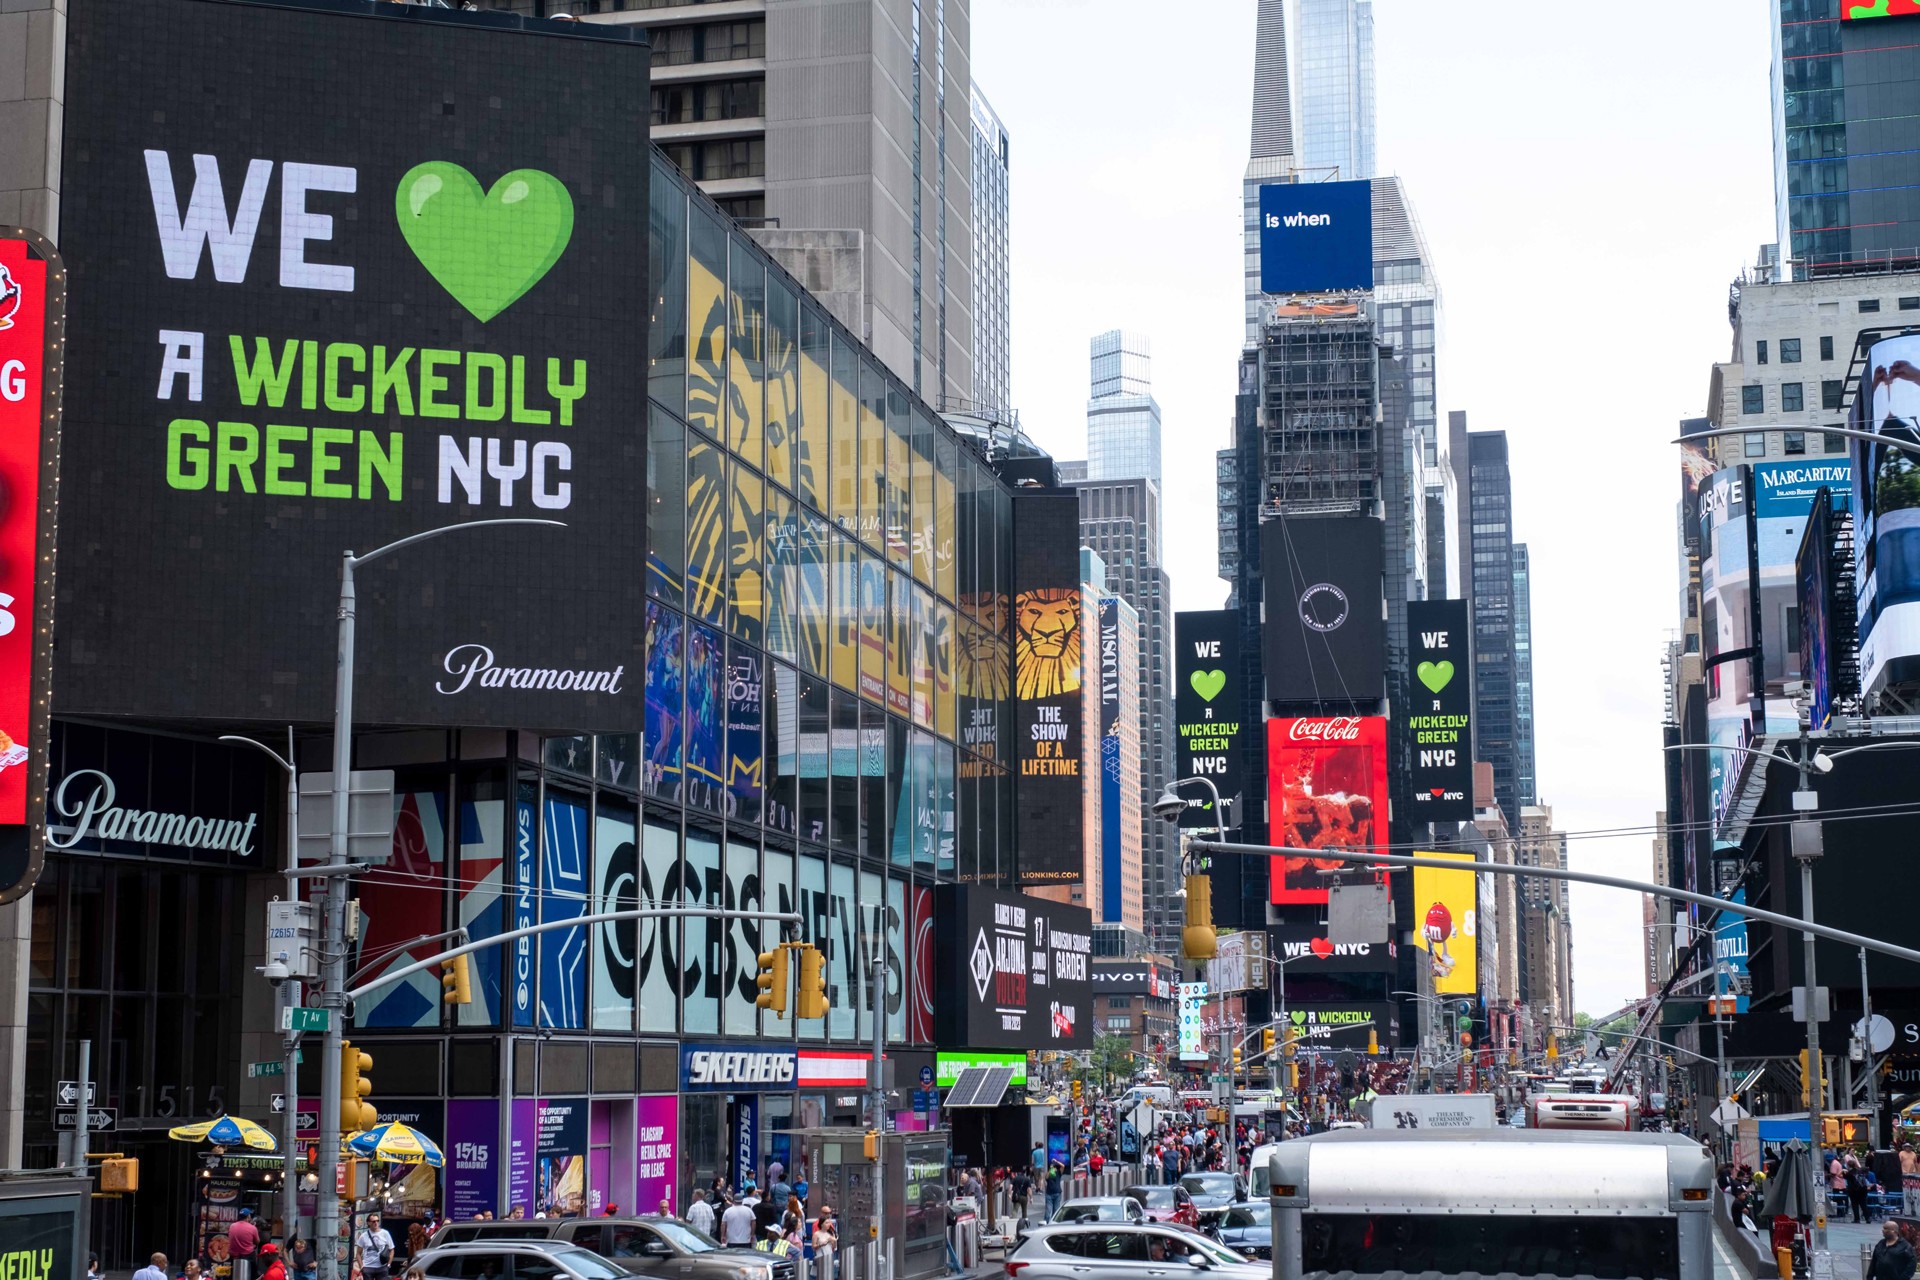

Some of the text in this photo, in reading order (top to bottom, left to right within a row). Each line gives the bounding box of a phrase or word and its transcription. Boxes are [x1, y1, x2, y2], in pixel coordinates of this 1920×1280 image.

[144, 149, 357, 292] WE
[1266, 212, 1330, 227] is when
[157, 329, 587, 426] A WICKEDLY
[166, 418, 572, 509] GREEN NYC
[1700, 480, 1743, 518] USIVE
[1421, 631, 1449, 649] WE
[1194, 641, 1221, 659] WE
[436, 644, 624, 694] Paramount
[862, 679, 884, 697] ENTRANCE
[1205, 708, 1212, 719] A
[1433, 700, 1441, 711] A
[1037, 706, 1061, 723] THE
[1410, 715, 1468, 730] WICKEDLY
[1031, 724, 1068, 741] SHOW
[1180, 722, 1239, 738] WICKEDLY
[1417, 730, 1458, 744] GREEN
[1036, 741, 1063, 758] OF A
[1190, 738, 1229, 751] GREEN
[1192, 756, 1227, 774] NYC
[1420, 750, 1456, 767] NYC
[1021, 759, 1078, 776] LIFETIME
[1188, 798, 1203, 807] WE
[1416, 791, 1464, 801] WE NYC
[47, 769, 257, 856] Paramount
[1021, 871, 1079, 879] LIONKING.COM
[516, 807, 531, 982] CBS NEWS
[270, 928, 295, 938] 726157
[662, 858, 902, 1015] CBS NEWS
[1034, 917, 1043, 947] 17
[1050, 930, 1091, 953] MADISON SQUARE
[1284, 942, 1370, 956] WE NYC
[996, 936, 1026, 974] ARJONA
[1032, 951, 1046, 971] JUNIO
[1056, 951, 1086, 981] GARDEN
[302, 1011, 320, 1027] 7 Av
[1050, 1001, 1061, 1038] 10
[1308, 1011, 1316, 1024] A
[1318, 1011, 1372, 1023] WICKEDLY
[256, 1065, 262, 1076] W
[265, 1063, 275, 1075] 44
[689, 1051, 795, 1084] SKECHERS
[1889, 1069, 1920, 1082] sun
[136, 1085, 225, 1118] 1515
[63, 1116, 107, 1124] ON WAY
[539, 1108, 547, 1116] THE
[641, 1126, 664, 1142] FLAGSHIP
[641, 1144, 671, 1160] RETAIL SPACE
[739, 1104, 750, 1194] SKECHE
[223, 1157, 249, 1169] TIMES
[456, 1161, 488, 1169] BROADWAY
[641, 1162, 665, 1178] FOR LEASE
